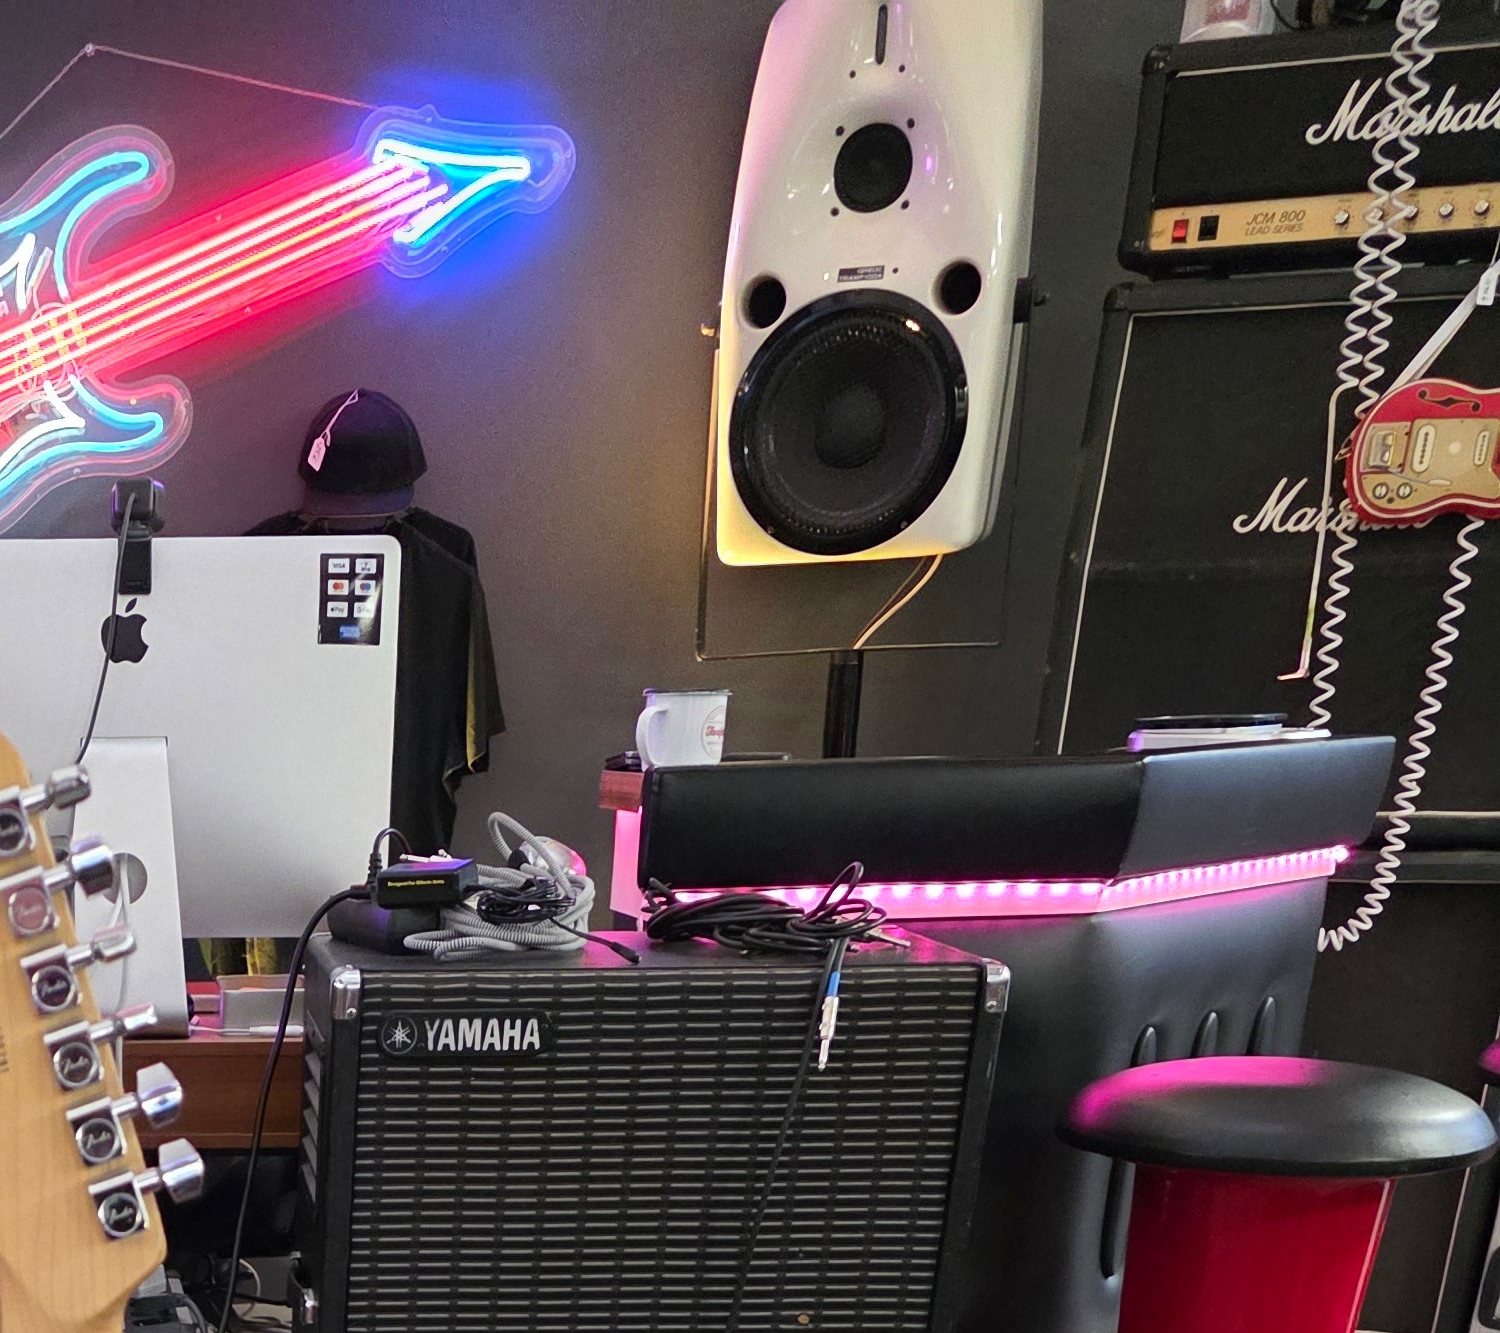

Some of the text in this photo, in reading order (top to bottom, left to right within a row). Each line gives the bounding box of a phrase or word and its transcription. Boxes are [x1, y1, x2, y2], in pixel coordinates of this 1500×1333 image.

[1245, 221, 1304, 237] LEAD SERIES
[1247, 209, 1306, 226] JCM 800
[1232, 476, 1437, 534] Mars
[424, 1018, 541, 1052] YAMAHA
